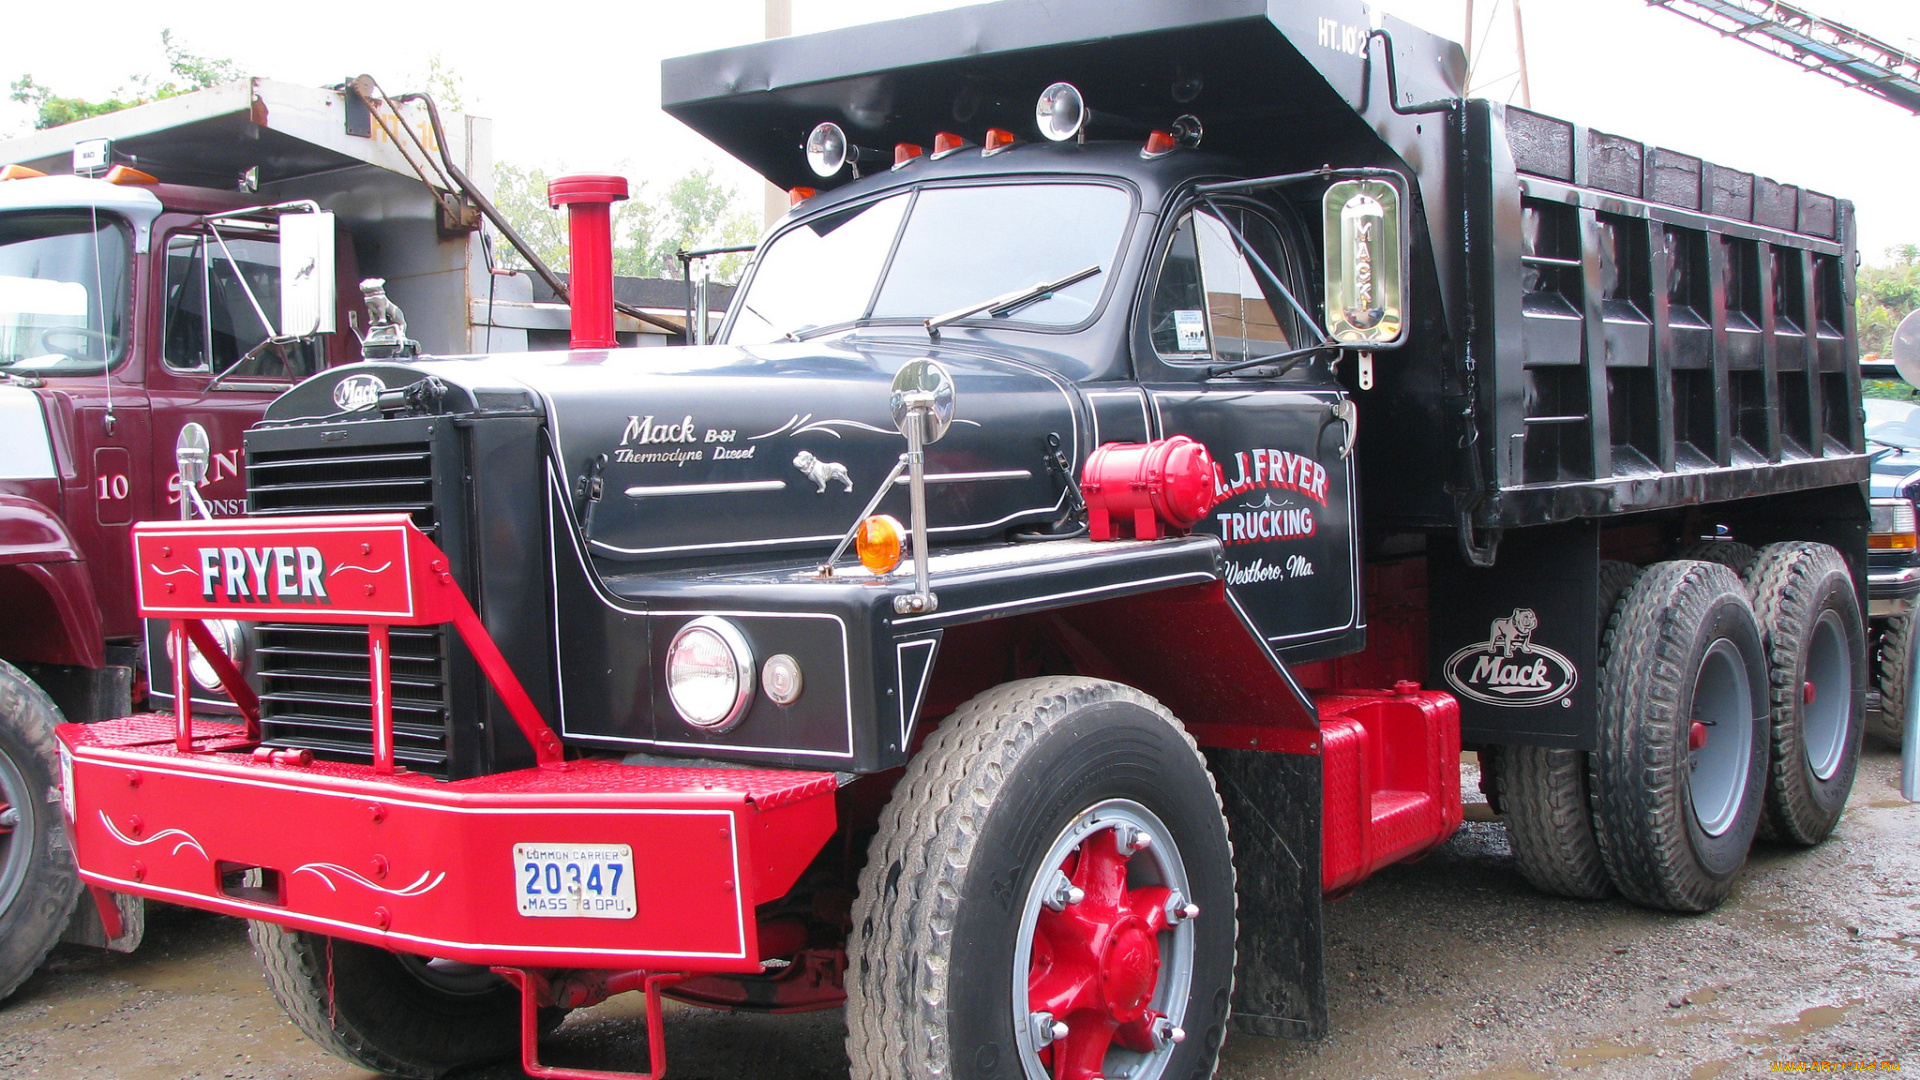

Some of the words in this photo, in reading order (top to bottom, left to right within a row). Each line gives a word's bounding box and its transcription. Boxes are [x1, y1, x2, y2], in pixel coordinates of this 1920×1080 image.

[1354, 221, 1372, 303] MACK
[339, 379, 379, 404] Mack
[620, 415, 697, 446] Mack
[704, 429, 737, 443] B-81
[614, 448, 703, 467] Thermodyne
[712, 445, 756, 460] Diesel
[98, 474, 129, 500] 10
[1252, 448, 1328, 502] FRYER
[1217, 507, 1314, 543] TRUCKING
[198, 546, 329, 602] FRYER
[1225, 557, 1284, 586] Westboro,
[1286, 554, 1314, 578] Ma.
[1468, 655, 1552, 694] Mack
[526, 850, 569, 860] COMMON
[573, 852, 619, 860] CARRIER
[525, 862, 623, 896] 20347
[528, 898, 567, 910] MASS
